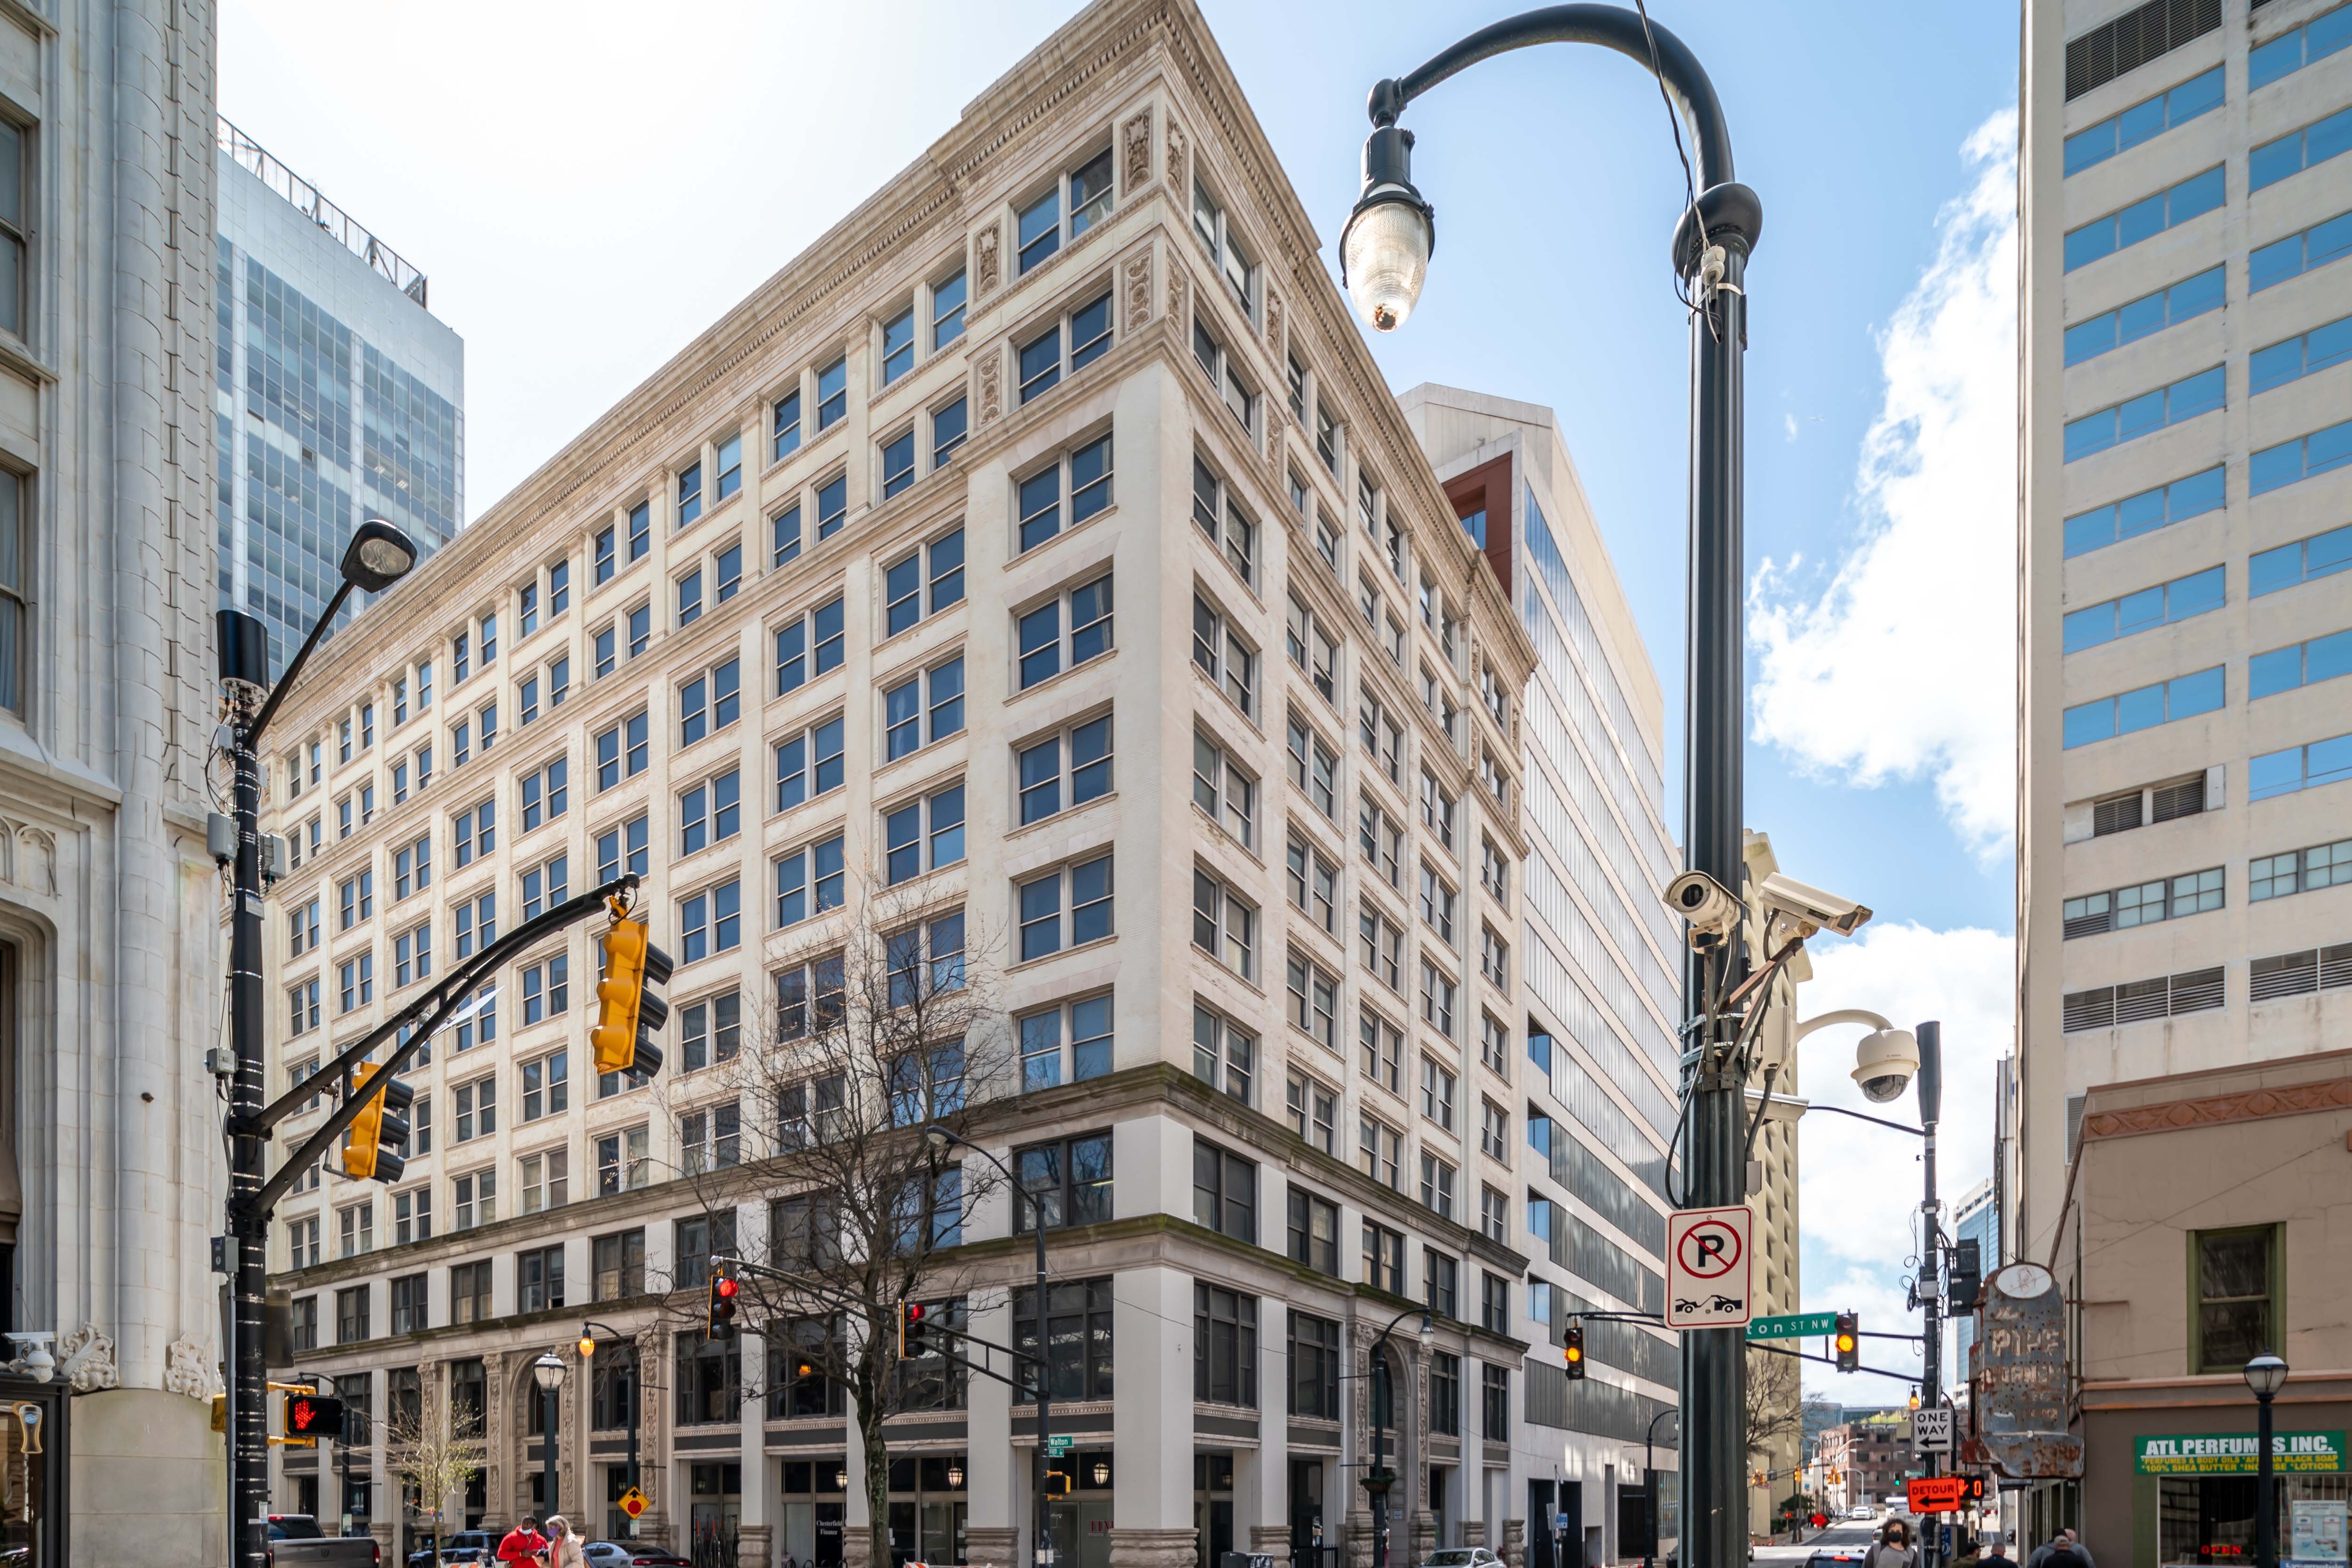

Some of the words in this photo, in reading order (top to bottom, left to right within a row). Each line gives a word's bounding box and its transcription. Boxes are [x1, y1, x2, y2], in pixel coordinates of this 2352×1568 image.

[1791, 1321, 1804, 1331] ST
[1812, 1319, 1828, 1329] NW
[1917, 1412, 1947, 1422] ONE
[1918, 1425, 1947, 1435] WAY
[2146, 1440, 2178, 1455] ATL
[2183, 1436, 2286, 1454] PERFUMS
[2290, 1435, 2333, 1452] INC.
[1912, 1485, 1954, 1495] DETOUR
[2201, 1544, 2241, 1555] OPEN
